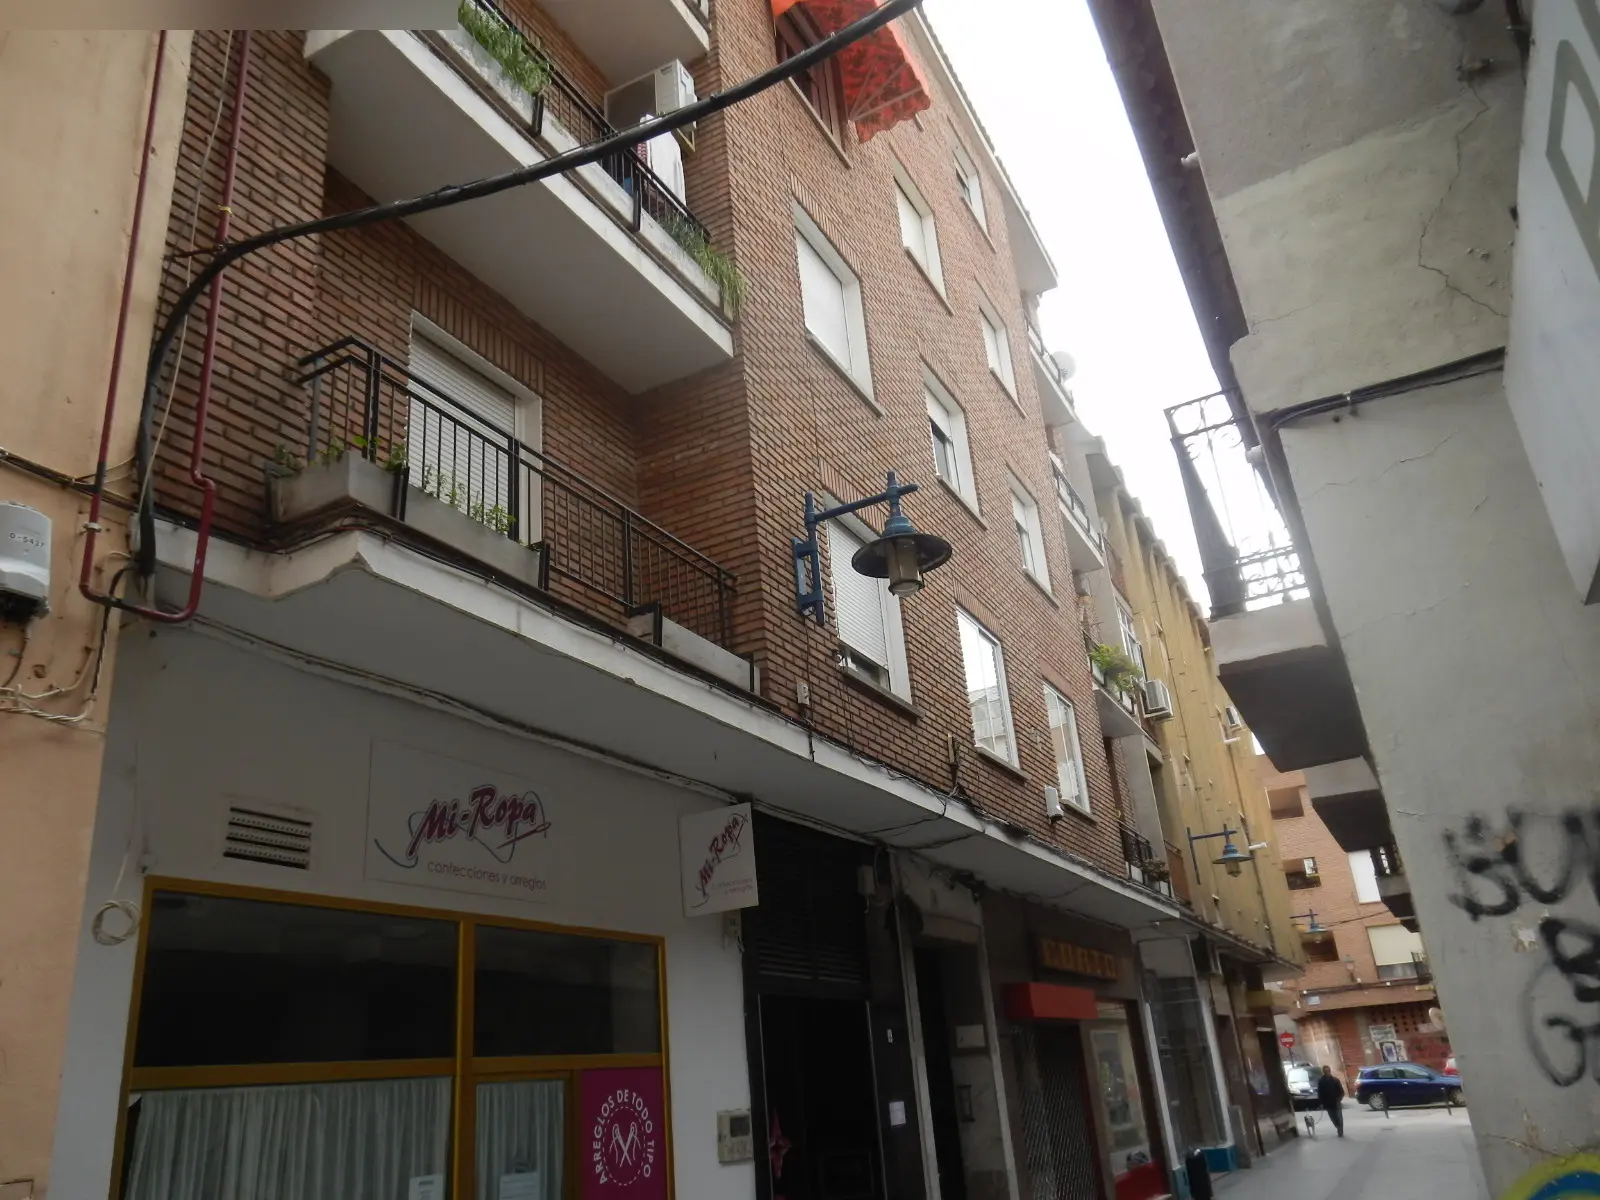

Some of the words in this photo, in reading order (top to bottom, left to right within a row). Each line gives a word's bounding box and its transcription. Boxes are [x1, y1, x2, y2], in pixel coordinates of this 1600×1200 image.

[405, 784, 538, 861] Mi-Ropa
[427, 861, 501, 884] confecciones
[501, 874, 509, 886] y
[509, 874, 548, 892] arreglos
[592, 1095, 615, 1185] ARREGLOS
[616, 1089, 629, 1104] DE
[631, 1091, 653, 1134] TODO
[643, 1139, 655, 1178] TIPO
